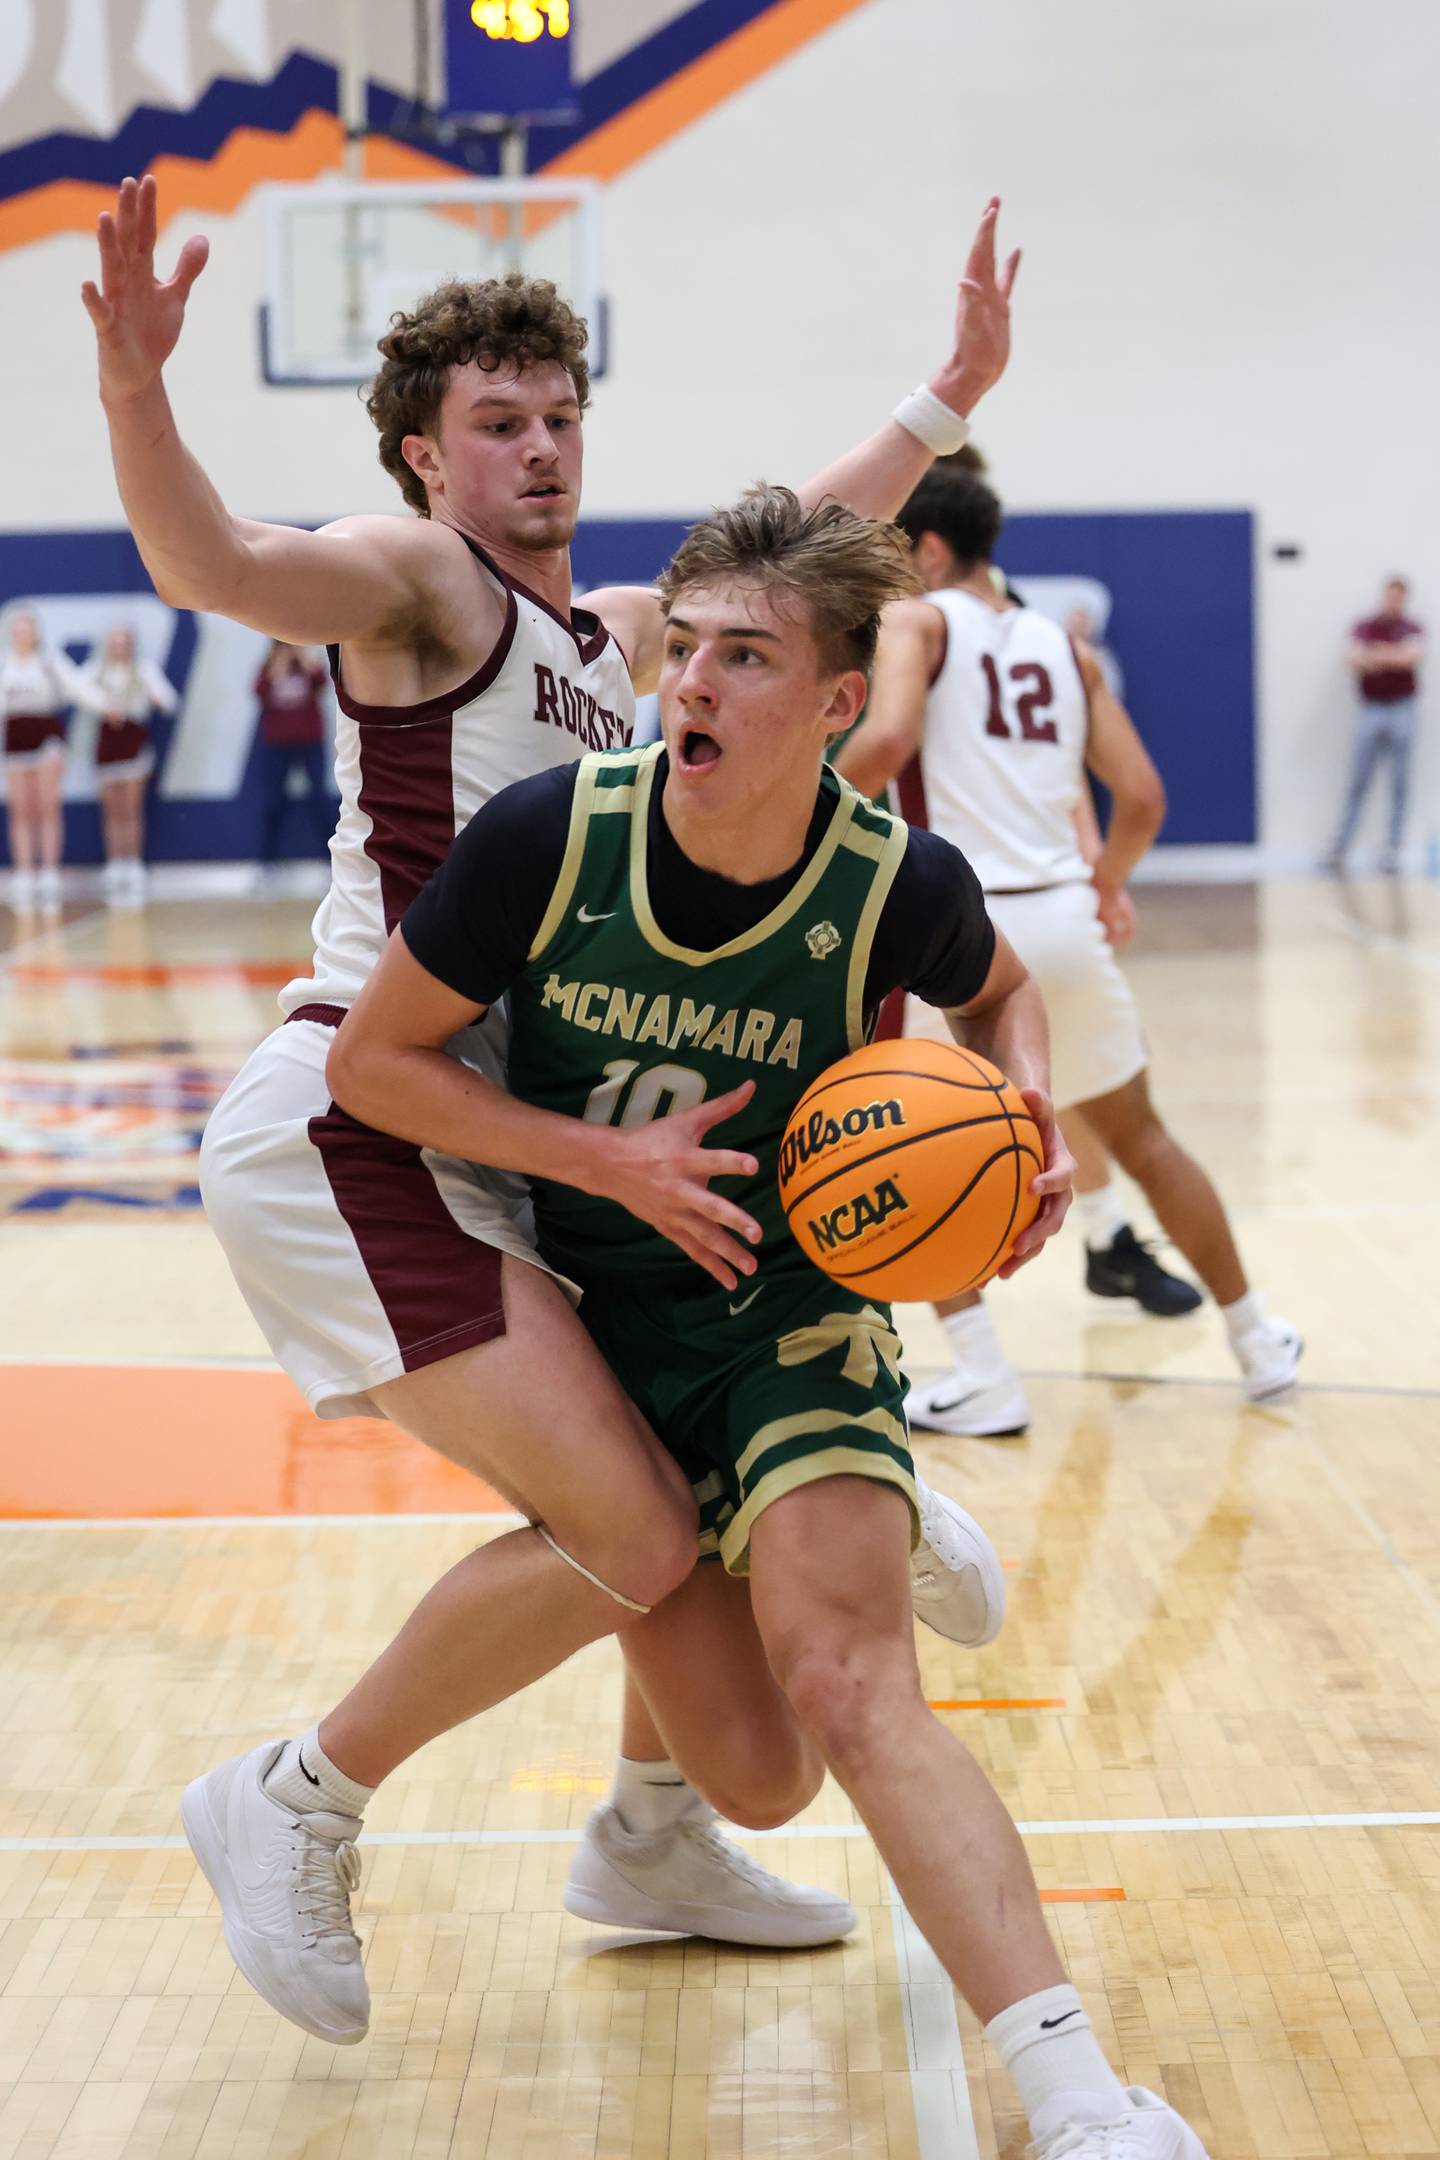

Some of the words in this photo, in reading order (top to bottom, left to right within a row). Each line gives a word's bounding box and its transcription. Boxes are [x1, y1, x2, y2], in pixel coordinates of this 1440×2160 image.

[981, 653, 1057, 743] 12
[541, 974, 803, 1070] MCNAMARA
[808, 1178, 909, 1252] NCAA
